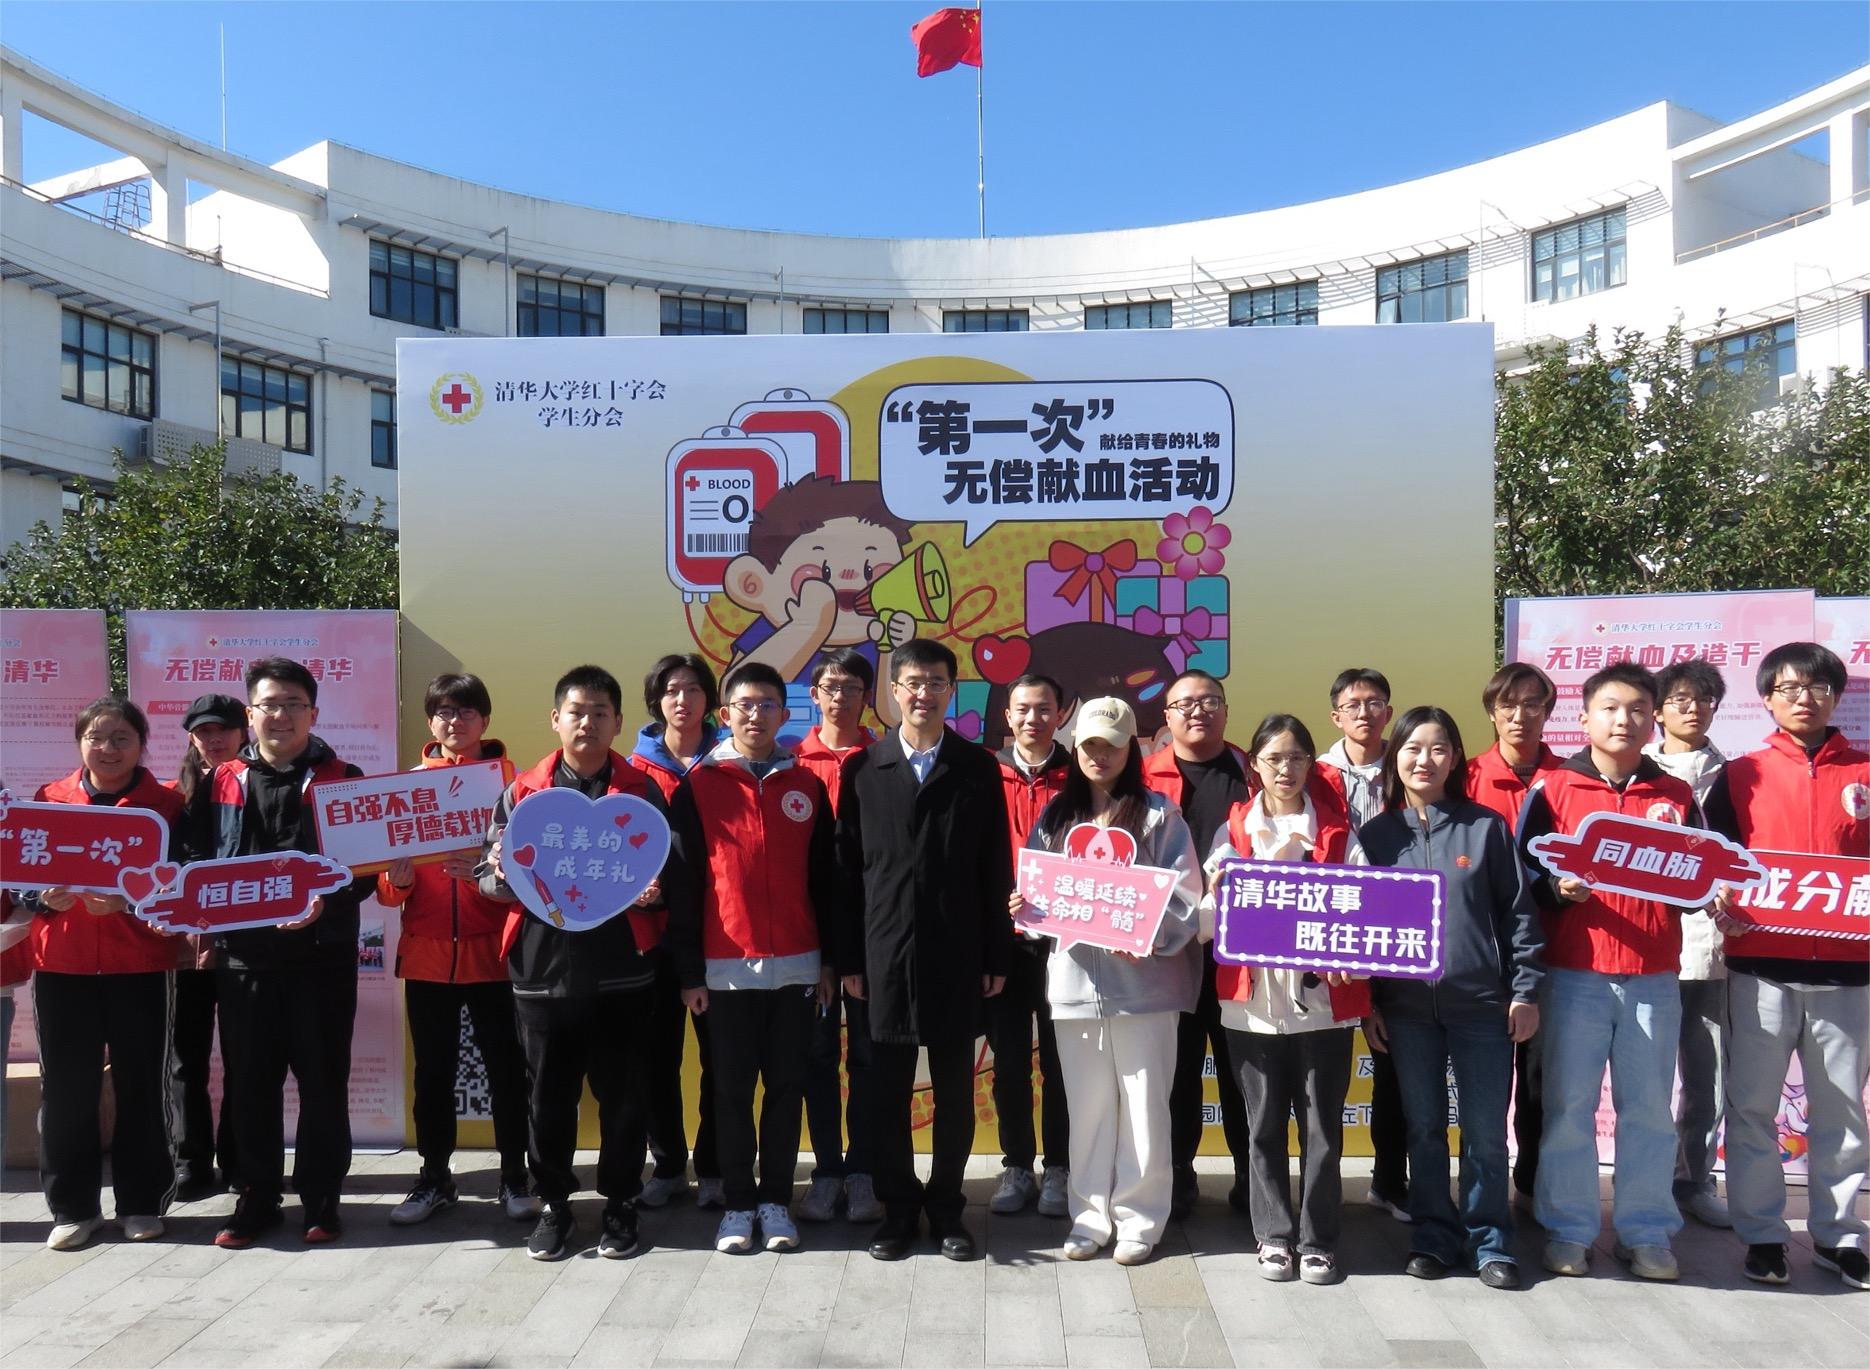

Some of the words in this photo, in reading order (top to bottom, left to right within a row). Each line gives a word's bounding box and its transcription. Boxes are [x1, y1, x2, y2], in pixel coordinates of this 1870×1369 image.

[495, 379, 667, 402] 清华大学红十字会
[538, 405, 624, 428] 学生分会
[886, 398, 1115, 455] “第一次”
[1099, 432, 1220, 451] 献给青春的礼物
[708, 478, 751, 489] BLOOD
[942, 456, 1220, 505] 无偿献血活动
[722, 494, 750, 524] O
[325, 786, 440, 828] 自强不息
[540, 823, 623, 854] 最美的
[553, 856, 636, 884] 成年礼
[1592, 836, 1704, 882] 同血脉
[197, 873, 293, 910] 恒自强
[1053, 874, 1138, 908] 温暖延续
[1232, 876, 1362, 915] 清华故事
[1295, 920, 1428, 959] 既往开来
